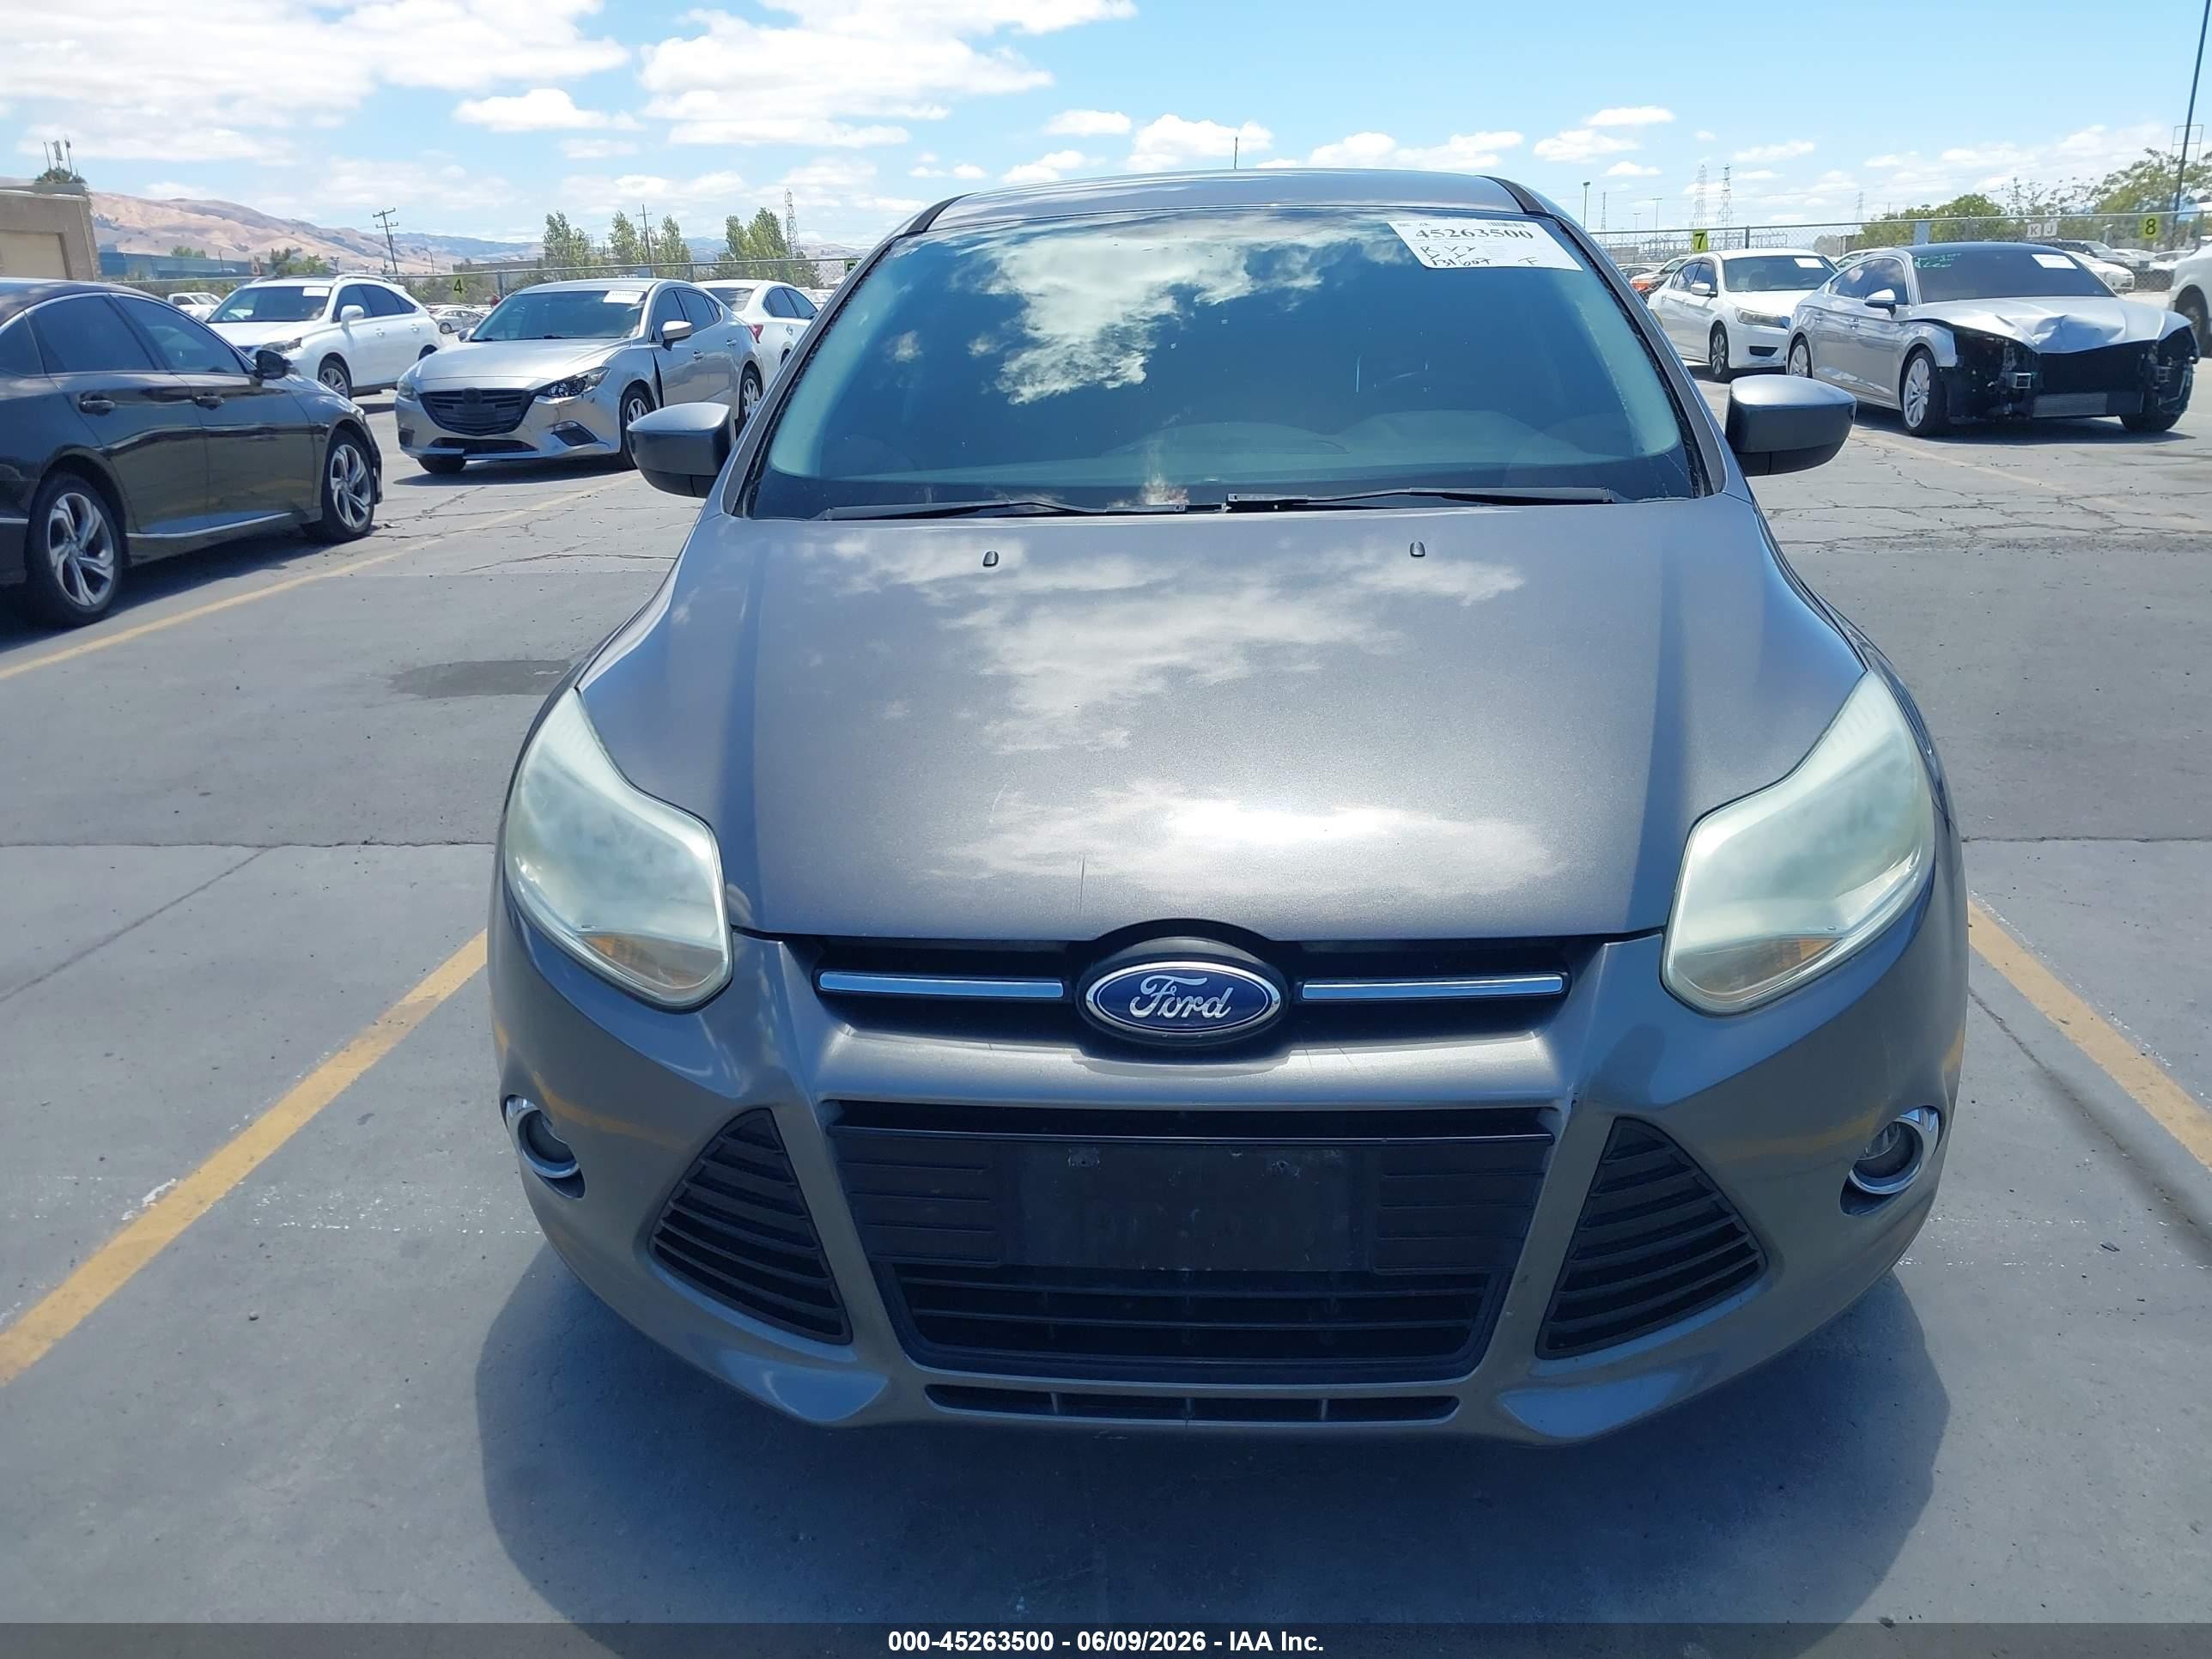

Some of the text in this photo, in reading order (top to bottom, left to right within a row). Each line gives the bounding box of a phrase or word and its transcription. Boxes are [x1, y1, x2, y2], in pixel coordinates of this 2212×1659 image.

[2031, 226, 2039, 235] K
[2146, 218, 2156, 234] 8
[1416, 228, 1534, 240] 45263500
[1695, 233, 1705, 249] 7
[453, 279, 464, 294] 4
[1129, 975, 1234, 1018] Ford
